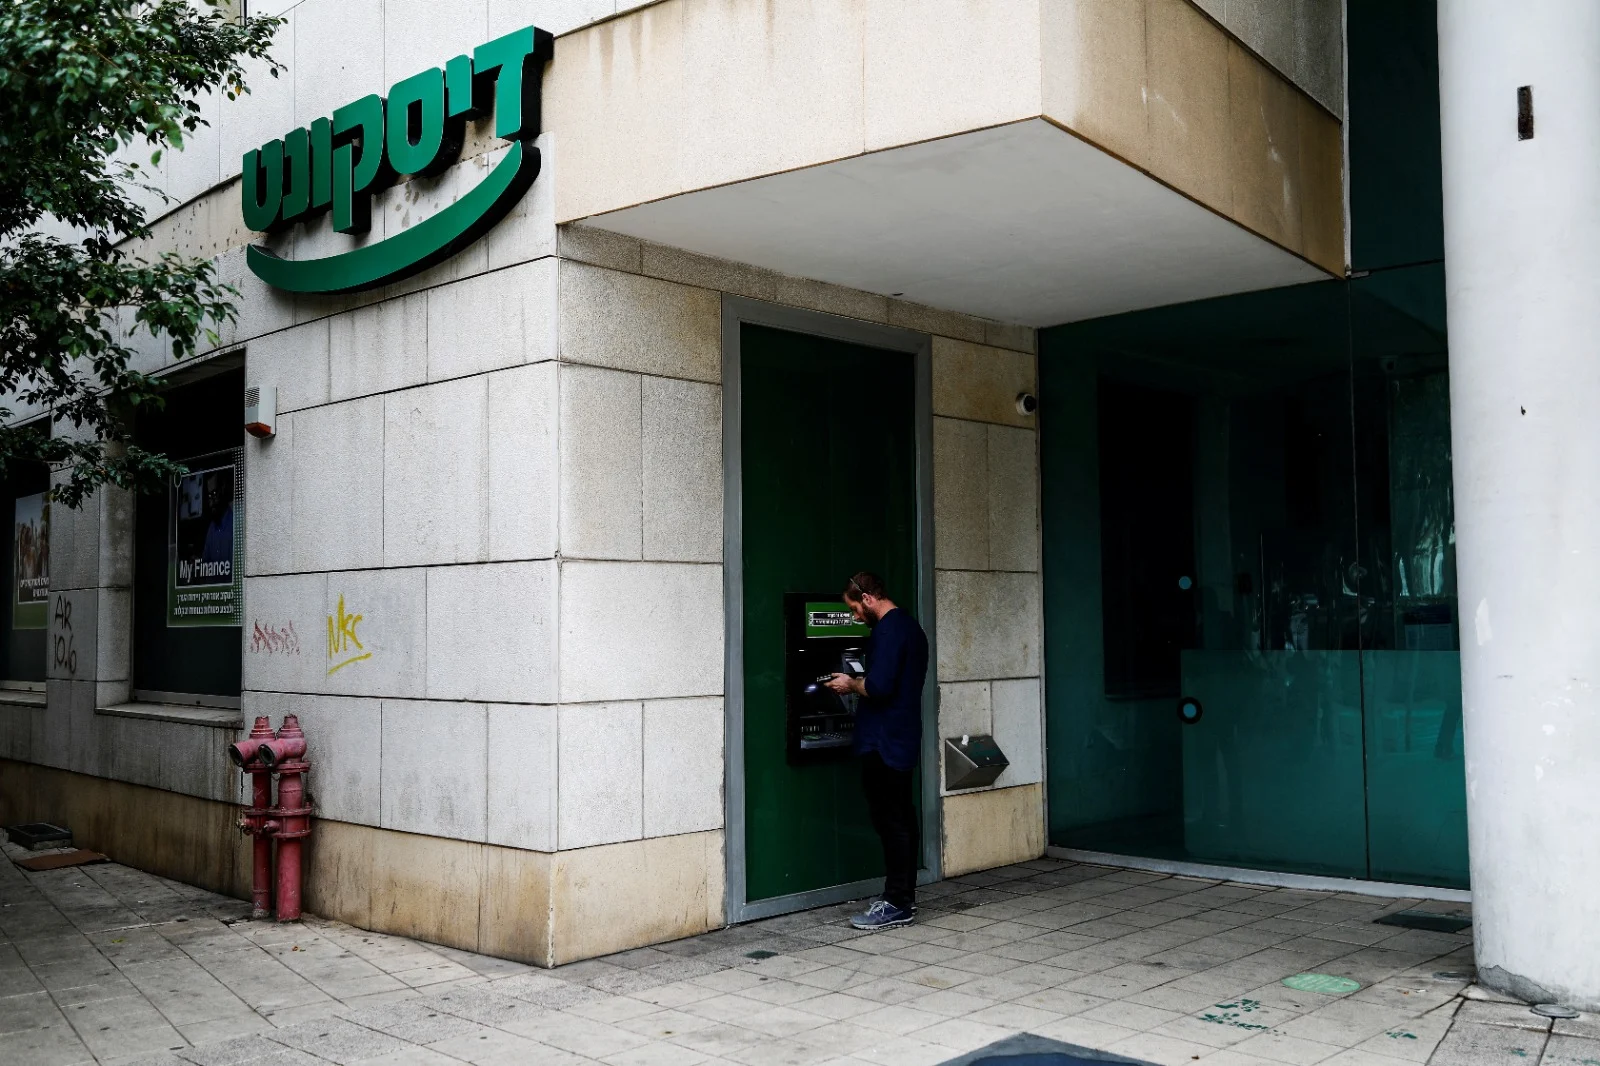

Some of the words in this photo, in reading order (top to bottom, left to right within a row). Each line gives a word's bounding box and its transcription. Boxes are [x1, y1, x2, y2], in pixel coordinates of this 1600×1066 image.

[242, 25, 536, 233] דיסקונט
[180, 560, 193, 583] My
[194, 558, 231, 578] Finance
